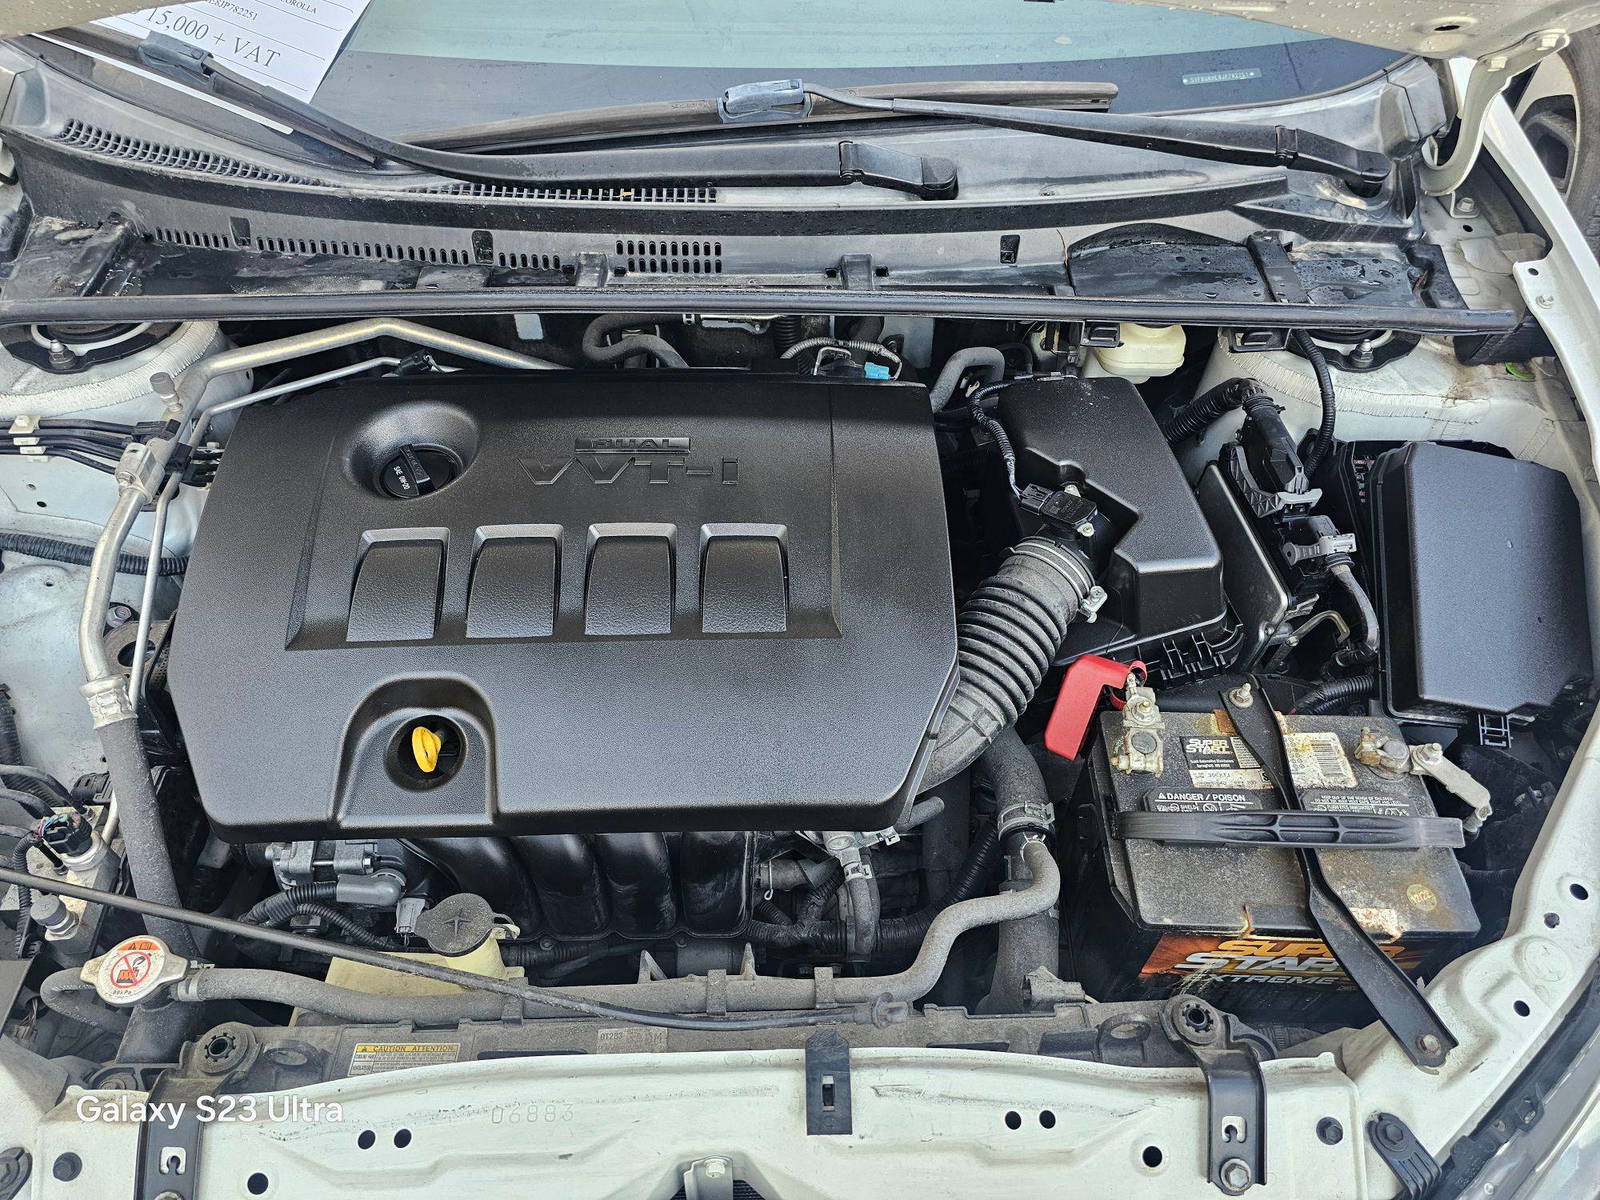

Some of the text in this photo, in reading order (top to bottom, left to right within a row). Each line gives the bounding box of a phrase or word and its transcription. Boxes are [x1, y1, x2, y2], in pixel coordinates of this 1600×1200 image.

[145, 7, 281, 68] 15,000 + VAT
[590, 437, 683, 450] DUAL
[393, 465, 403, 476] SAE
[1189, 738, 1228, 746] SUPER
[1185, 744, 1230, 753] START
[1166, 792, 1204, 801] DANGER
[1212, 793, 1246, 801] POISON
[1217, 940, 1405, 958] SUP
[1174, 952, 1340, 972] STAR
[374, 1044, 455, 1053] CAUTION ATTENTION
[490, 1103, 574, 1124] 06883
